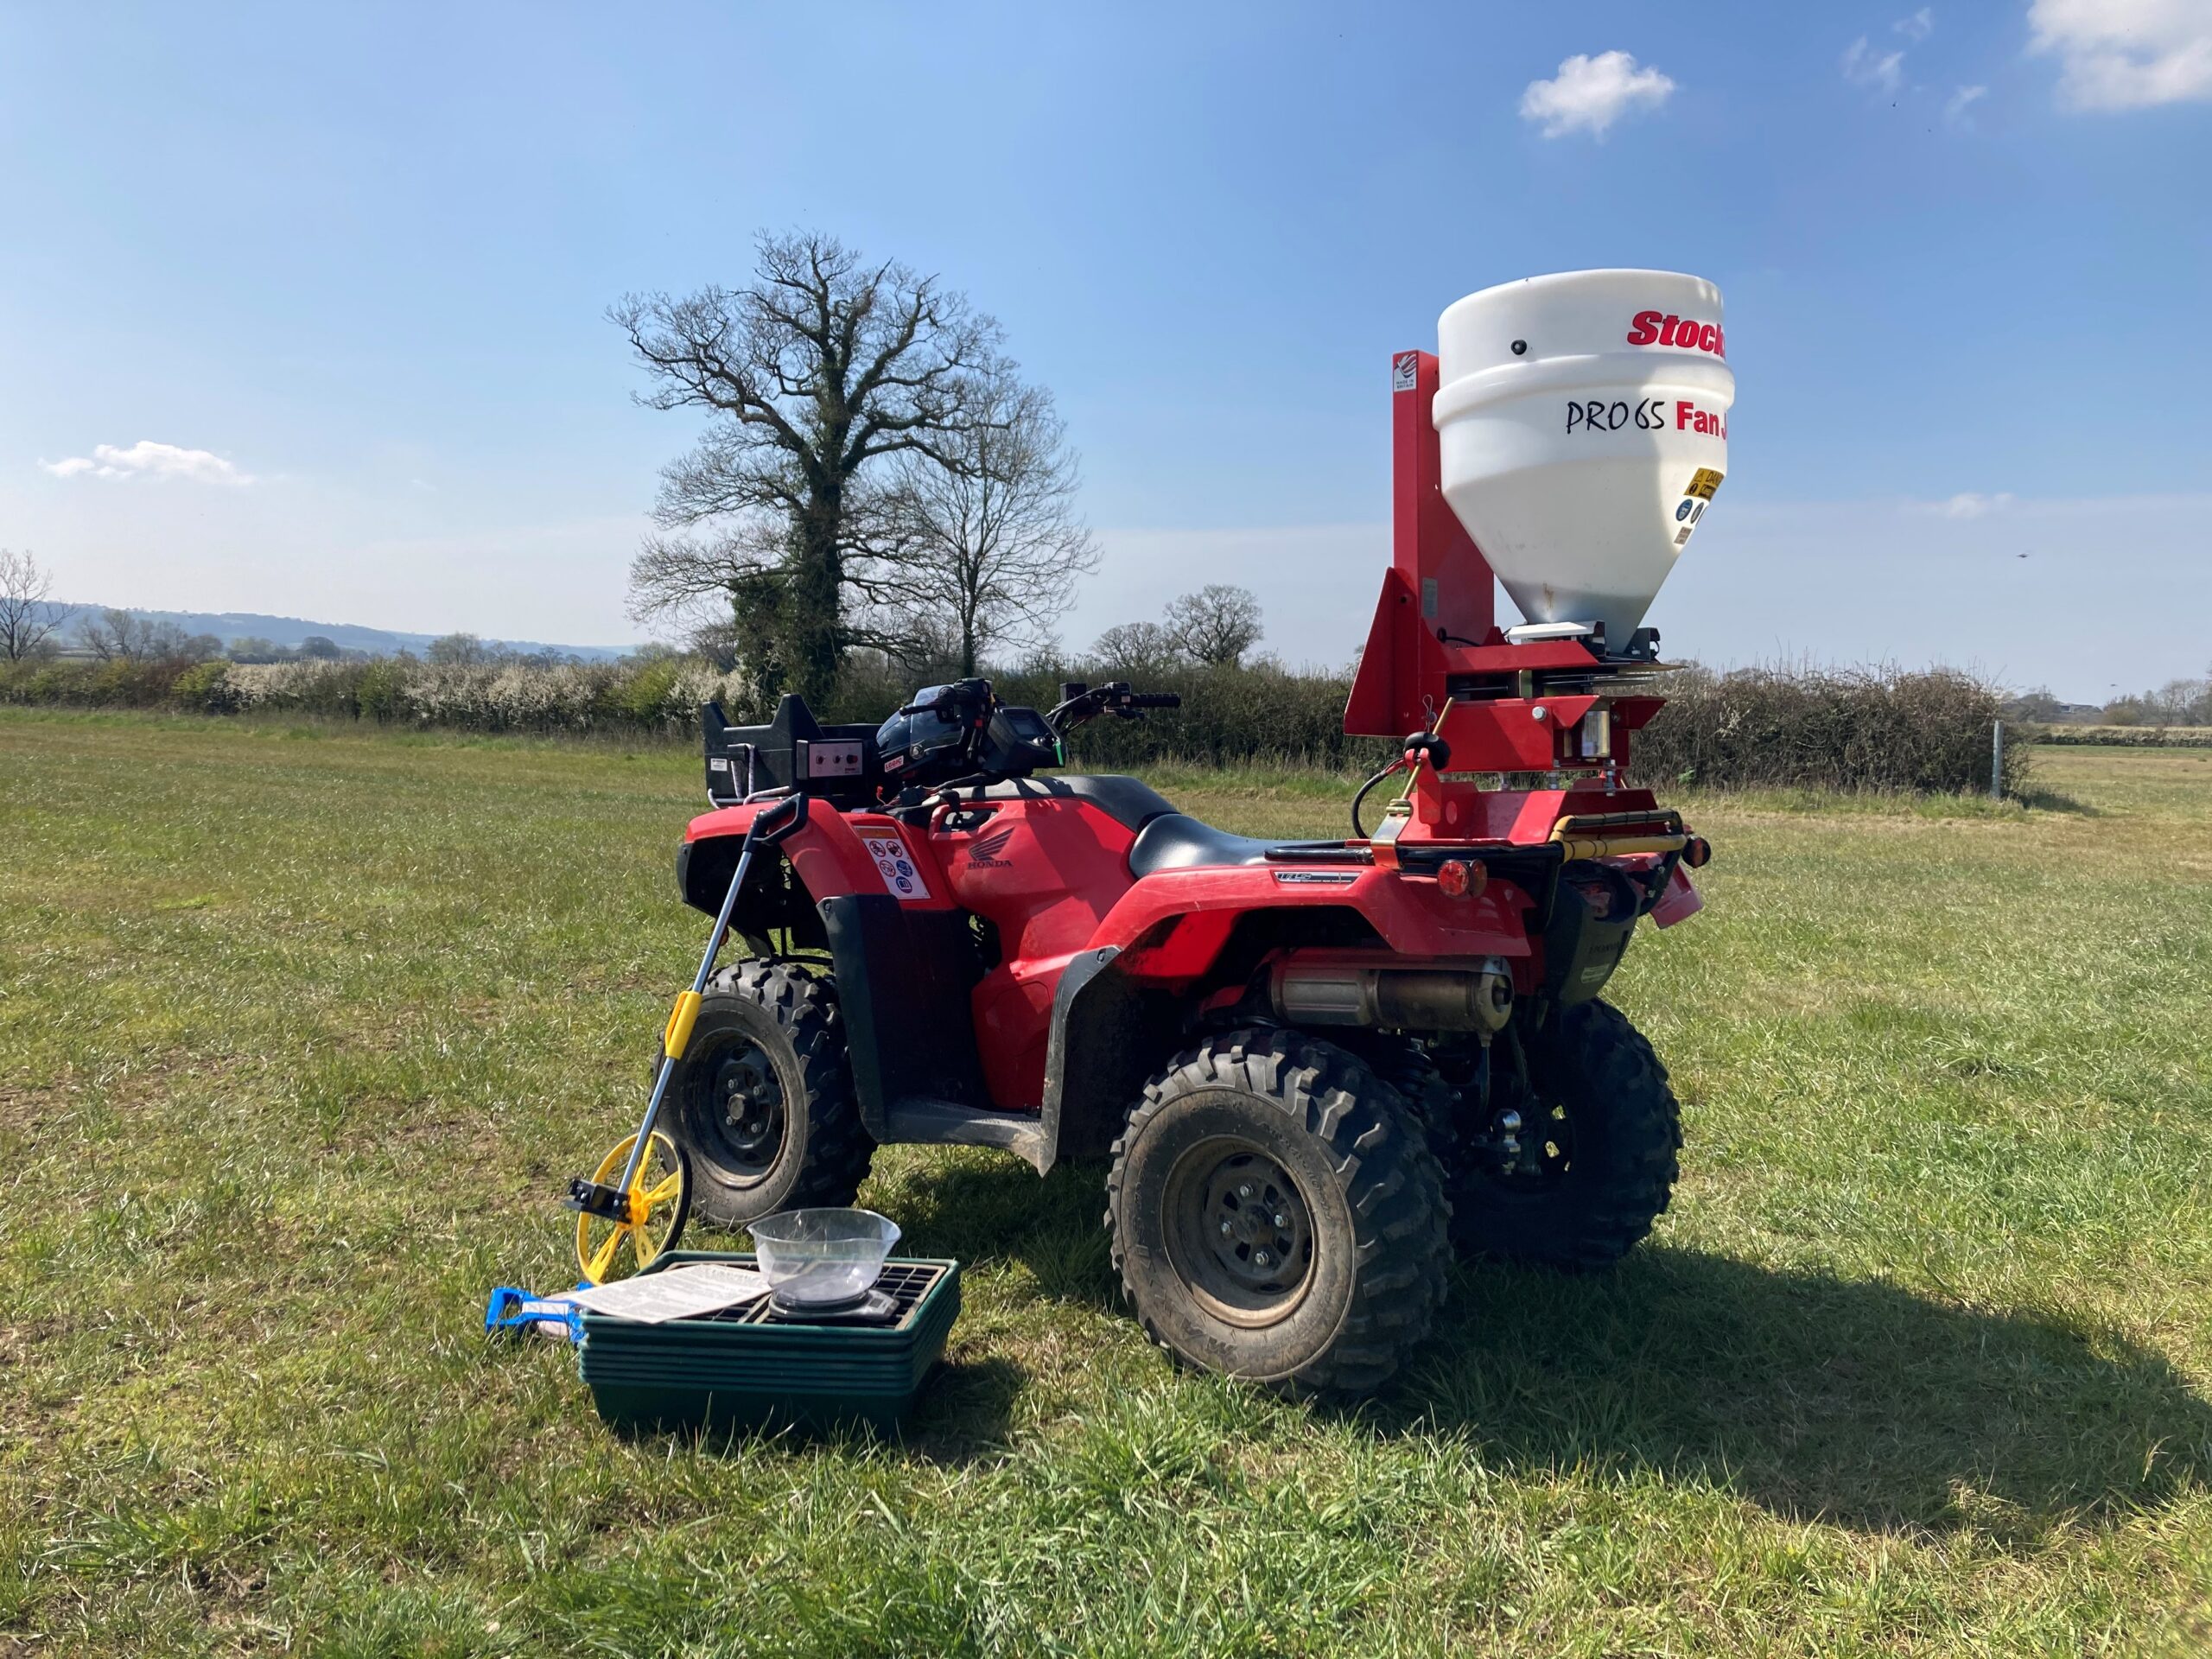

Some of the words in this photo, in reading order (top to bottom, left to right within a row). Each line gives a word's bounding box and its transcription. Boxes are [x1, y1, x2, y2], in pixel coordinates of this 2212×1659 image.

[1567, 401, 1629, 435] PRO
[1635, 397, 1665, 429] 65
[1676, 400, 1719, 437] Fan
[968, 860, 1014, 869] HONDA
